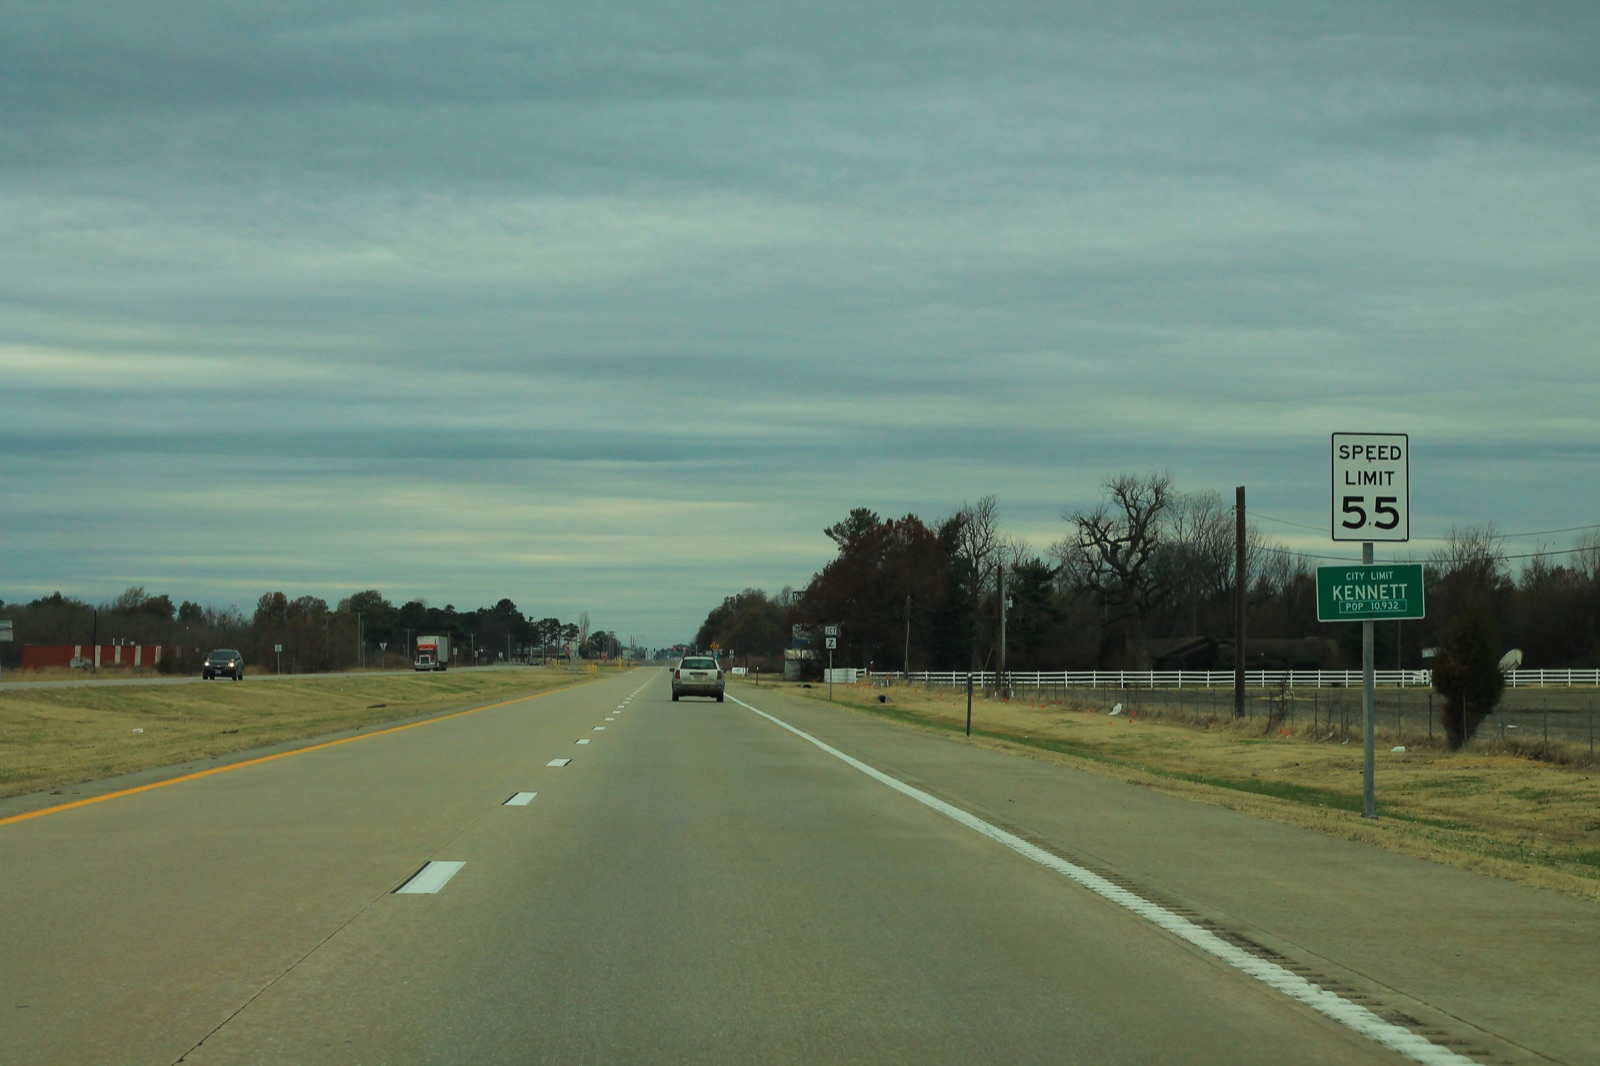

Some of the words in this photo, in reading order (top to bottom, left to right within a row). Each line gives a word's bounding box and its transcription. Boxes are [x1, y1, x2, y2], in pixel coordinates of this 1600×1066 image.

[1339, 445, 1401, 460] SPEED
[1346, 470, 1395, 486] LIMIT
[1342, 496, 1400, 530] 55
[1346, 572, 1365, 581] CITY
[1370, 571, 1393, 580] LIMIT
[1332, 583, 1408, 600] KENNETT
[1345, 602, 1364, 611] POP
[1371, 601, 1399, 611] 10,932
